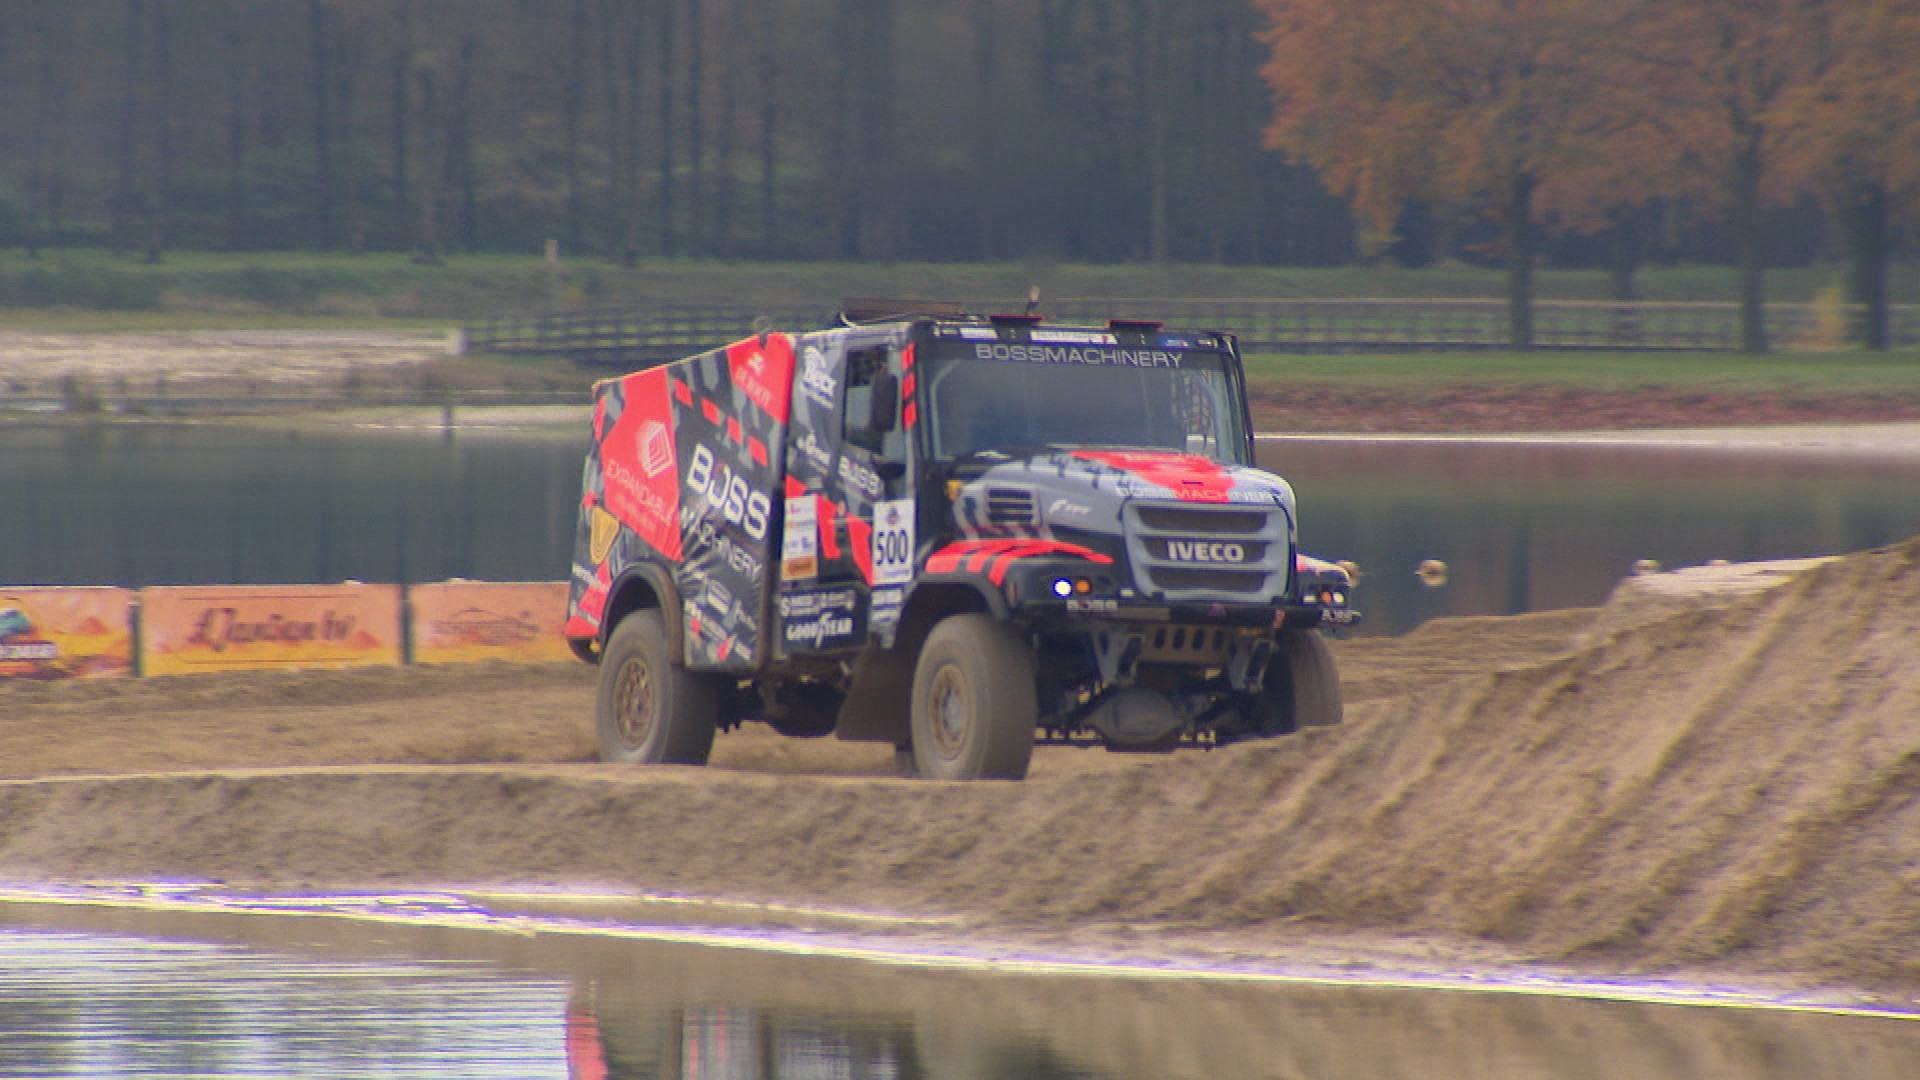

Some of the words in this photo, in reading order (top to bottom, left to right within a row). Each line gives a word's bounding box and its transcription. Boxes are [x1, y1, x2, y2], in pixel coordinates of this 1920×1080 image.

[975, 343, 1184, 368] BOSSMACHINERY
[877, 529, 909, 566] 500
[1168, 541, 1245, 562] IVECO
